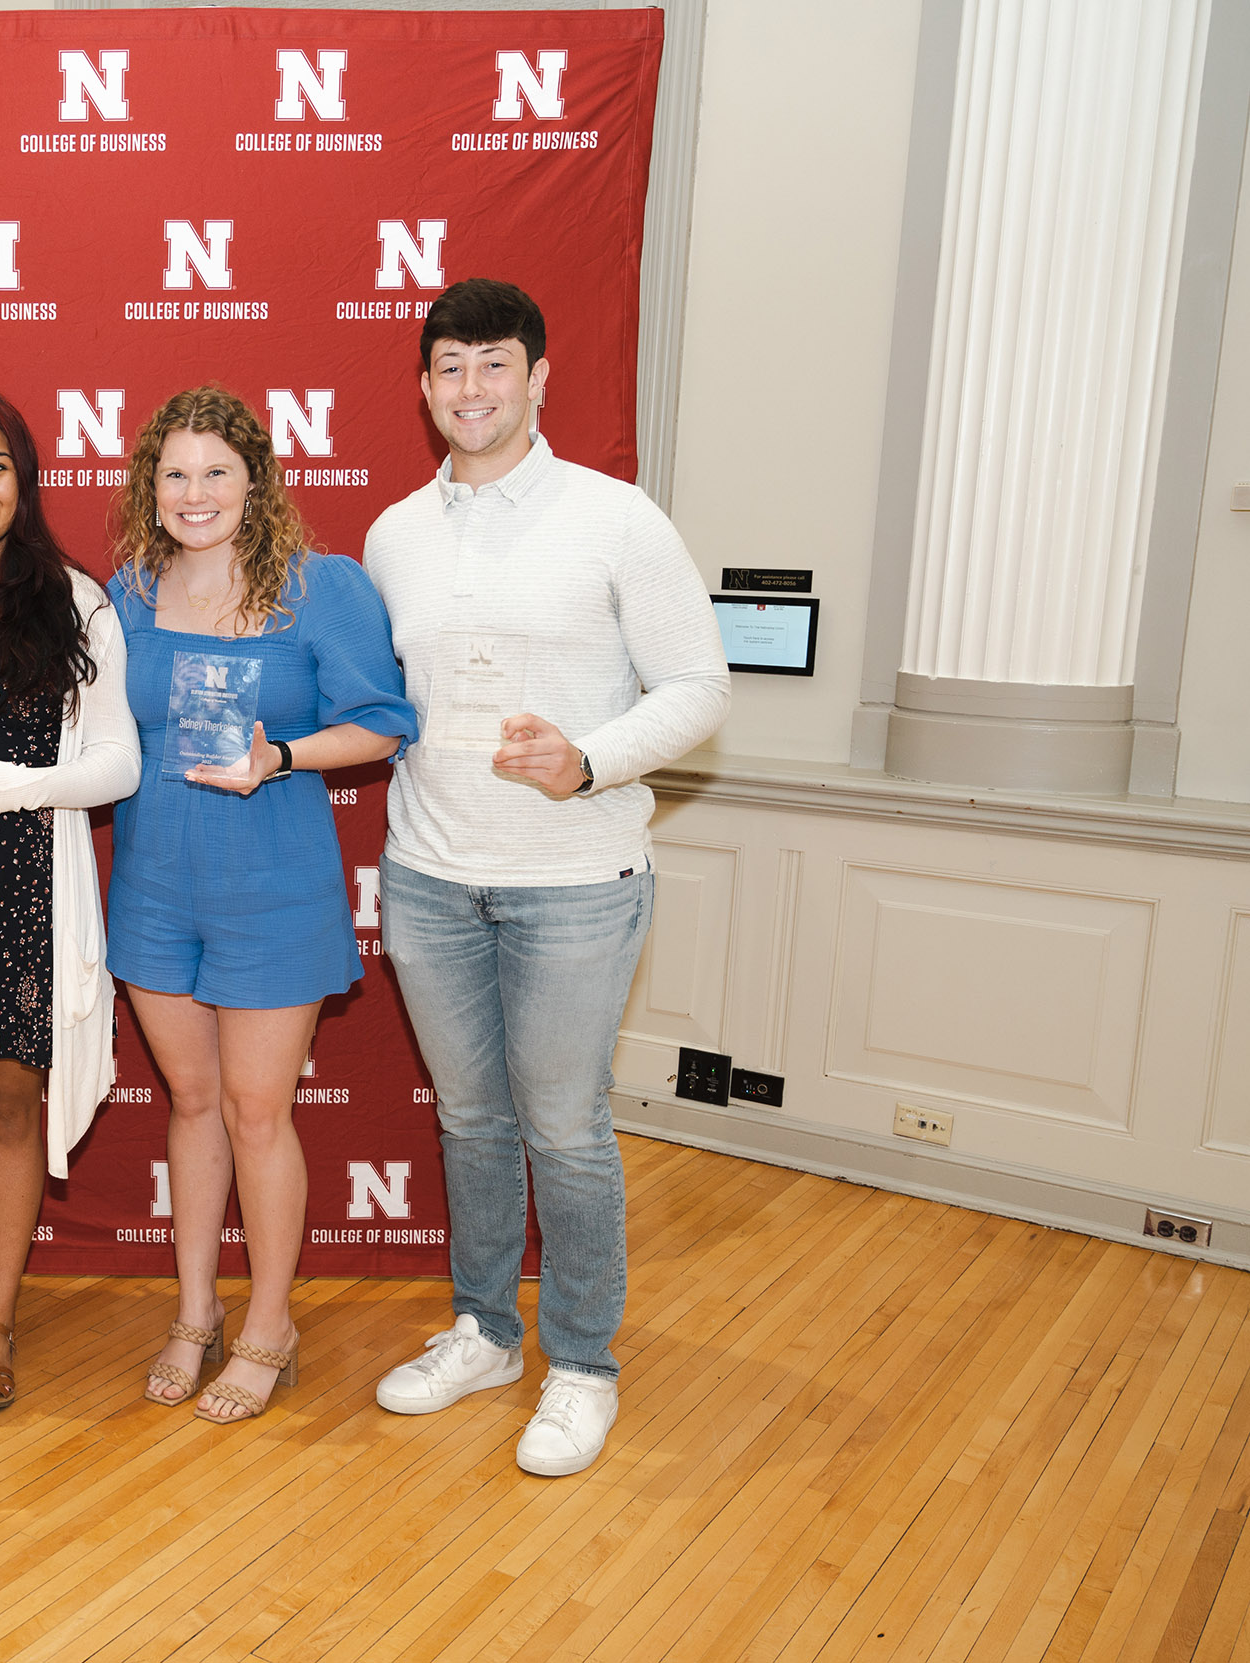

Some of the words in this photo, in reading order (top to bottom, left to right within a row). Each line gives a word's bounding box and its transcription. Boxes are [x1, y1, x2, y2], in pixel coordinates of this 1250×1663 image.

[59, 49, 129, 122] N
[275, 49, 348, 121] N
[492, 50, 568, 121] N
[20, 135, 76, 152] COLLEGE
[80, 134, 96, 152] OF
[100, 133, 166, 151] BUSINESS
[236, 133, 291, 151] COLLEGE
[296, 134, 312, 151] OF
[316, 134, 382, 151] BUSINESS
[451, 133, 508, 151] COLLEGE
[512, 132, 529, 150] OF
[533, 131, 598, 149] BUSINESS
[163, 220, 233, 290] N
[375, 219, 447, 289] N
[125, 302, 179, 320] COLLEGE
[184, 302, 198, 319] OF
[203, 302, 268, 319] BUSINESS
[337, 302, 391, 319] COLLEGE
[396, 302, 411, 319] OF
[56, 389, 125, 458] N
[266, 389, 334, 457] N
[78, 470, 93, 486] OF
[285, 470, 300, 486] OF
[305, 469, 368, 486] BUSINESS
[205, 665, 228, 689] N
[179, 717, 203, 731] Sidney
[347, 1160, 411, 1220] N
[117, 1228, 167, 1243] COLLEGE
[312, 1229, 362, 1243] COLLEGE
[366, 1229, 381, 1244] OF
[385, 1229, 445, 1244] BUSINESS
